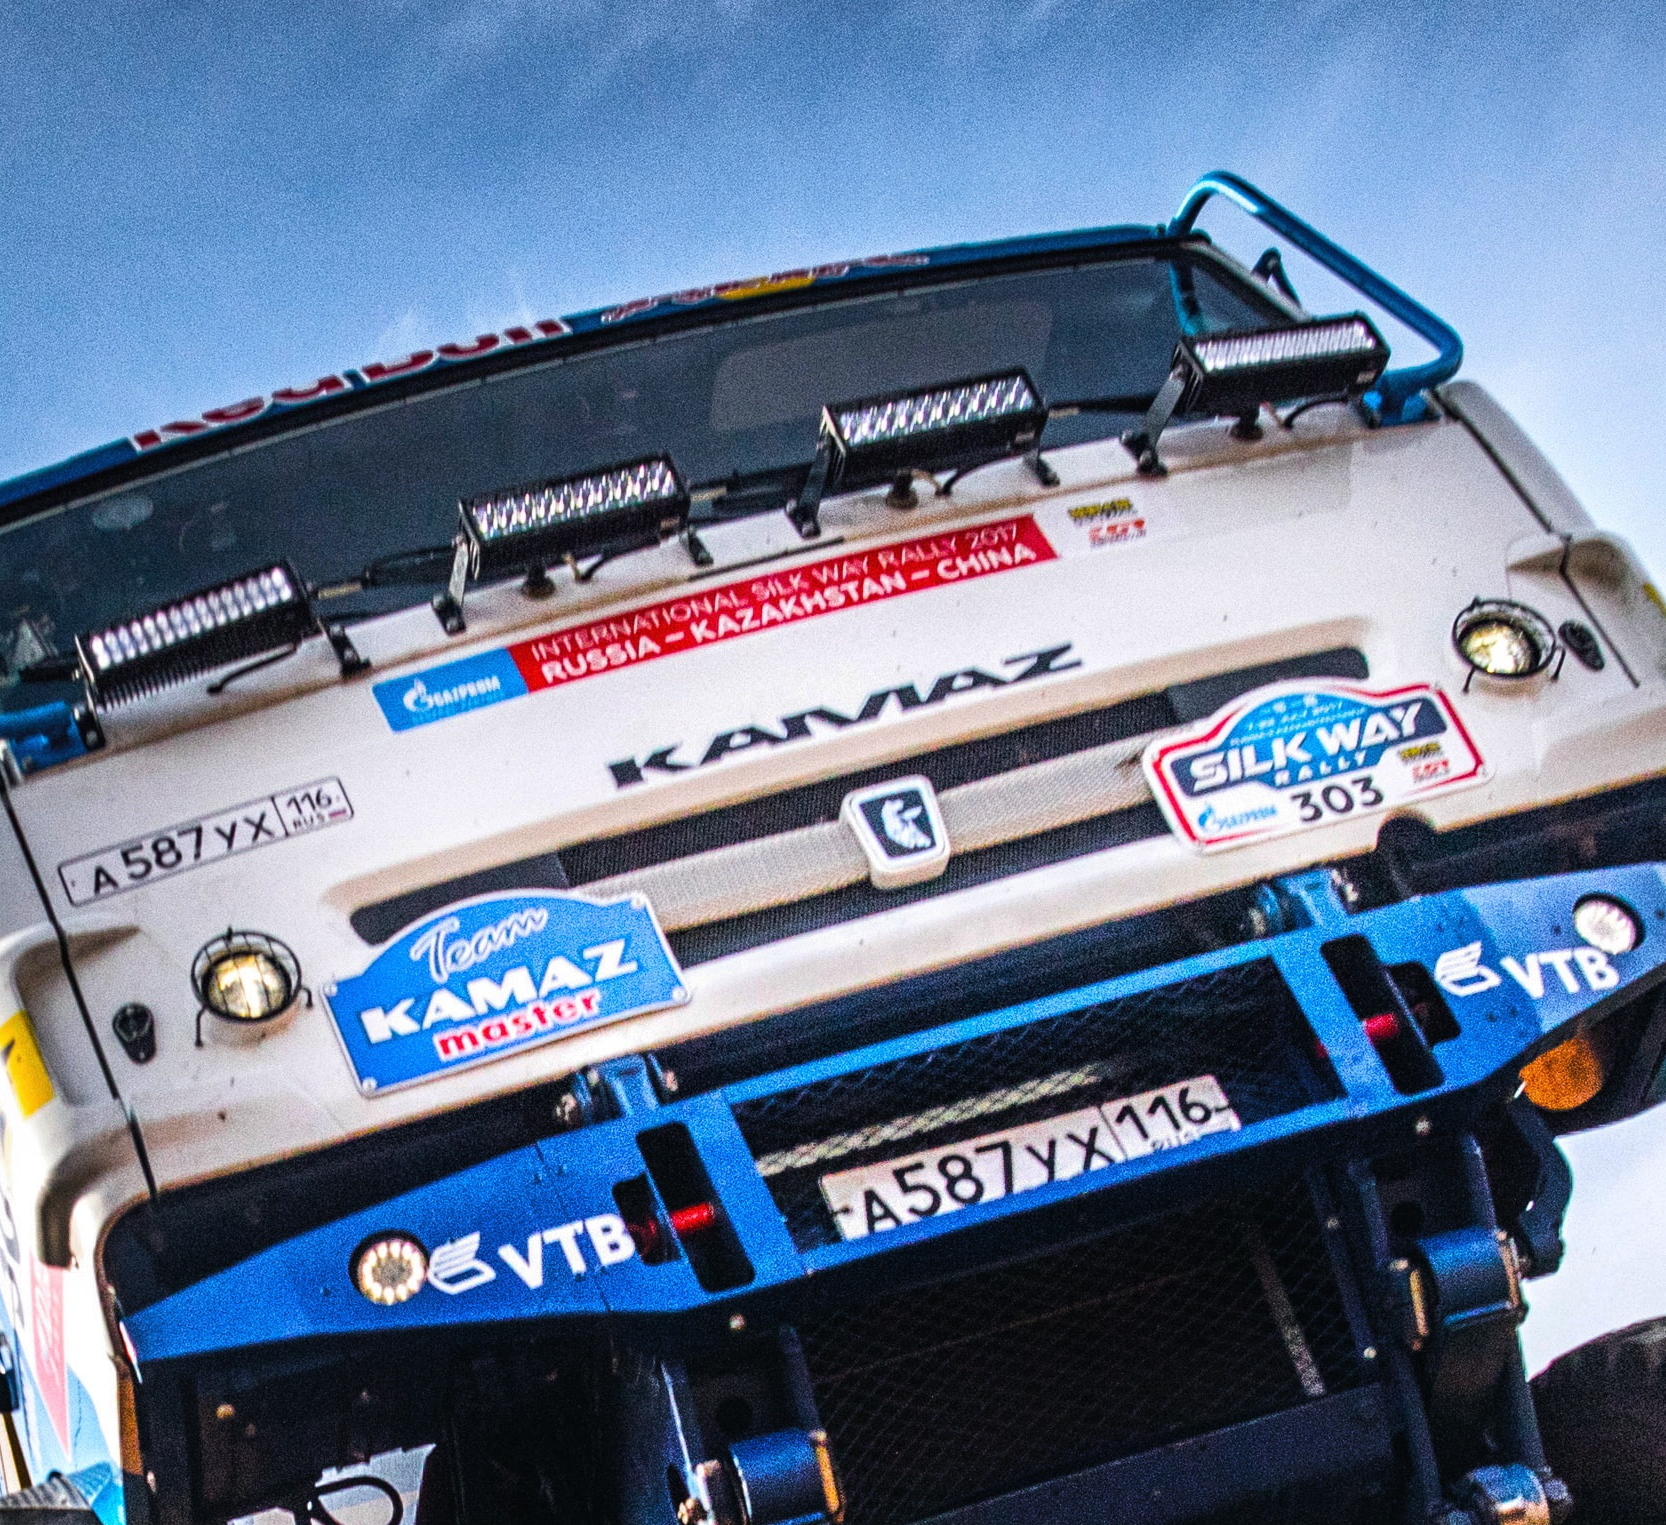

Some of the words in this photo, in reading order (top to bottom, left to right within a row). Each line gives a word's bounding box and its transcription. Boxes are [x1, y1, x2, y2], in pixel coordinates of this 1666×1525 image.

[531, 590, 748, 662] INTERNATIONAL
[751, 571, 809, 601] SILK
[812, 556, 868, 585] WAY
[878, 536, 956, 569] RALLY
[965, 524, 1017, 549] 2017
[541, 635, 661, 684] RUSSIA
[690, 571, 906, 643] KAZAKHSTAN
[937, 543, 1037, 580] CHINA
[607, 642, 1084, 789] KAMAZ
[1189, 731, 1312, 792] SILK
[1316, 701, 1423, 756] WAY
[286, 787, 332, 815] 116
[1275, 749, 1366, 787] RALLY
[1290, 776, 1384, 823] 303
[410, 907, 548, 984] Team
[1499, 946, 1620, 999] VTB
[360, 939, 638, 1044] KAMAZ
[435, 990, 600, 1058] master
[1115, 1087, 1211, 1140] 116
[497, 1213, 634, 1289] VTB
